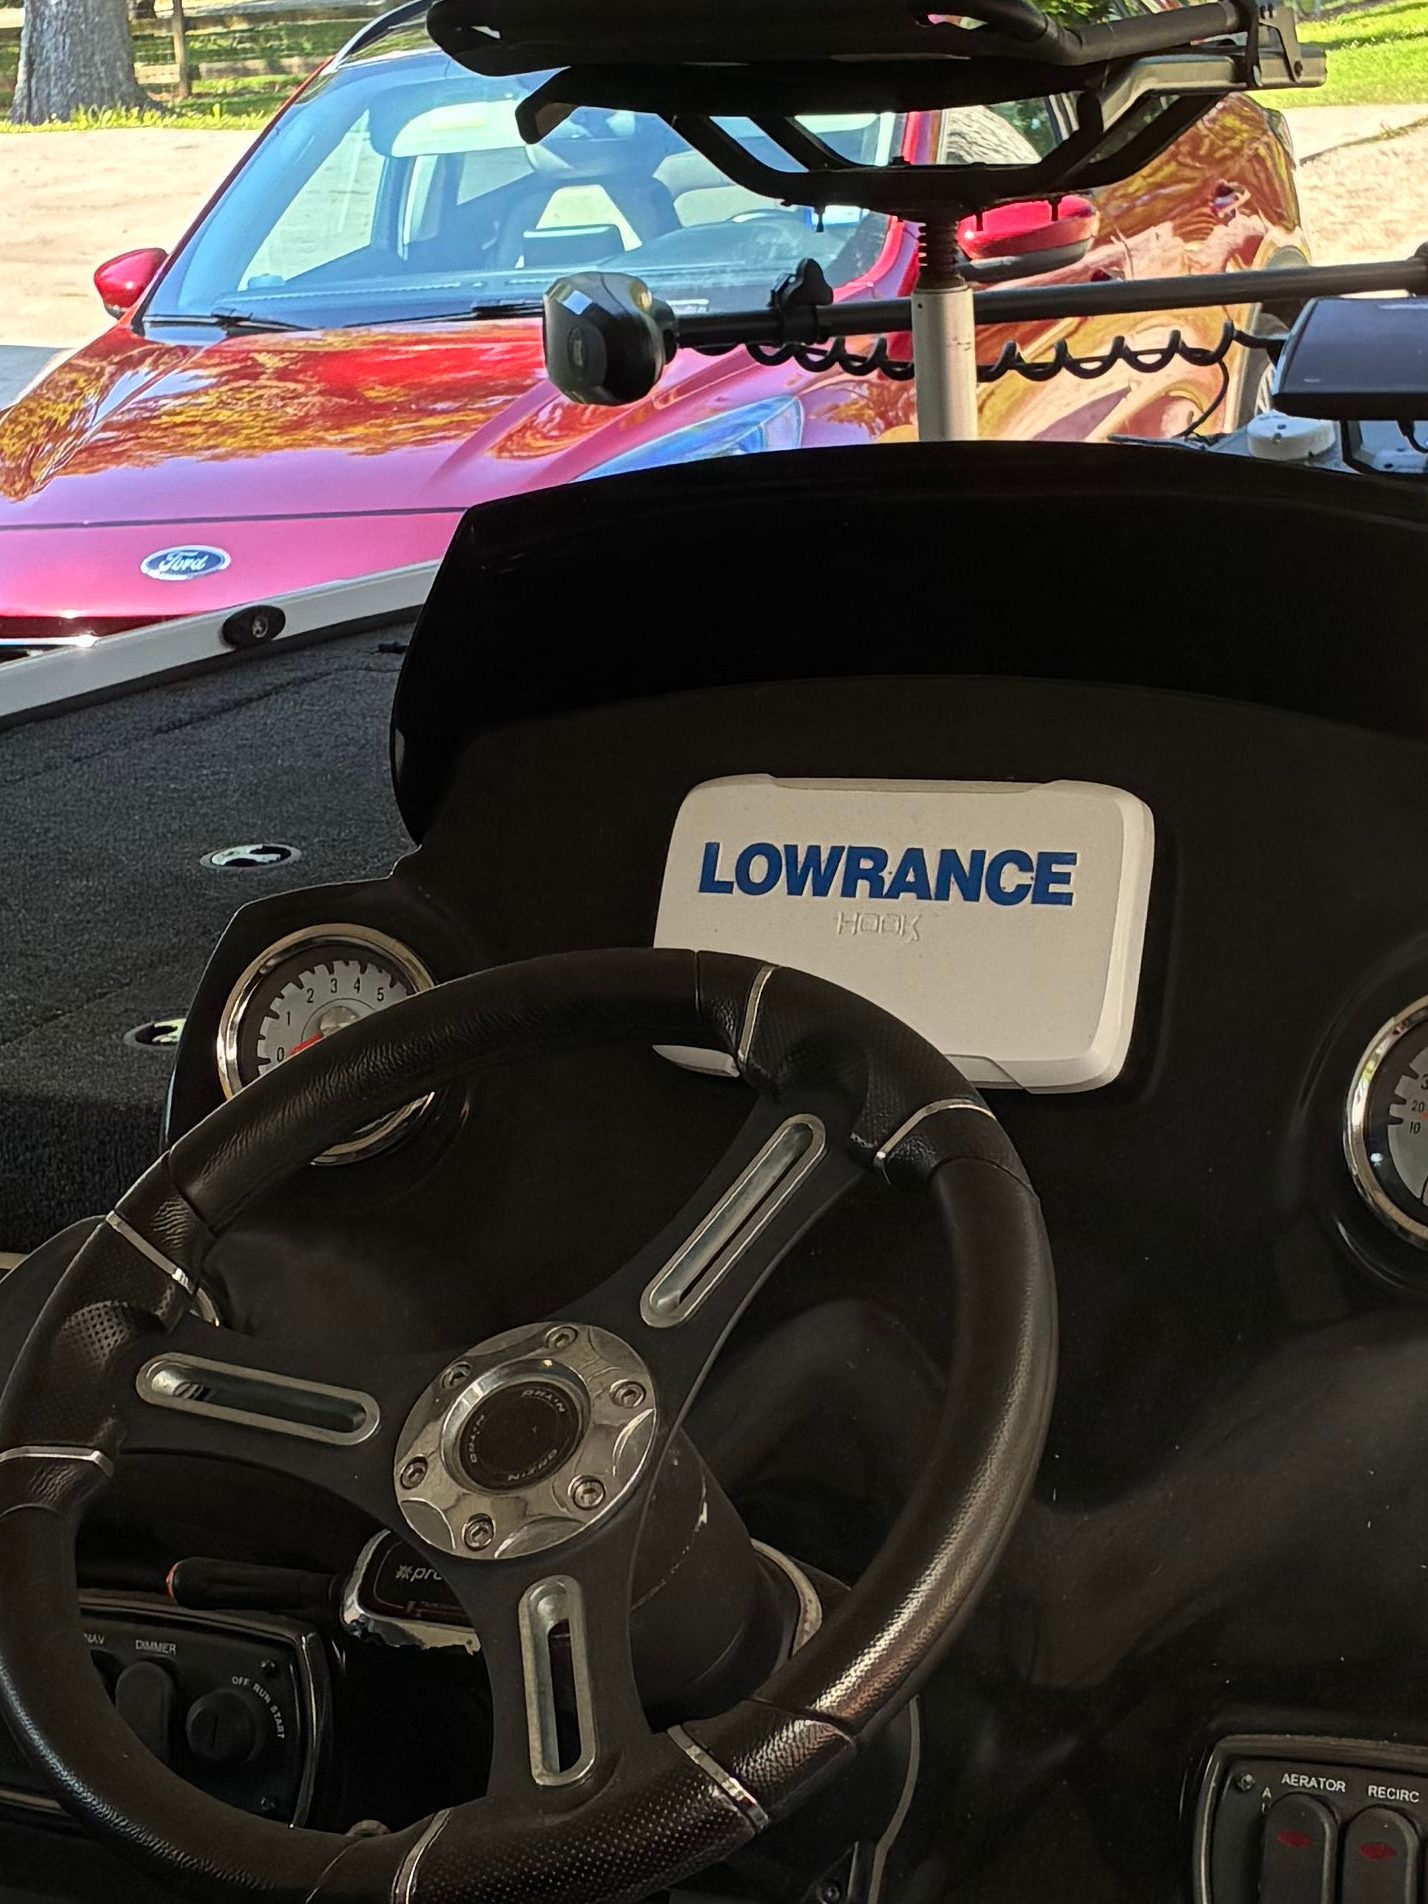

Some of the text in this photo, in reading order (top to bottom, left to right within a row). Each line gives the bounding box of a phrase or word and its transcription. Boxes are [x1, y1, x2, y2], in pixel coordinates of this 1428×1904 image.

[158, 550, 209, 572] Ford
[698, 841, 1078, 907] LOWRANCE
[836, 911, 922, 942] HOOK
[330, 978, 338, 994] 3
[353, 976, 361, 994] 4
[306, 987, 315, 1004] 2
[376, 986, 385, 1002] 5
[285, 1011, 291, 1027] 1
[276, 1046, 285, 1062] 0
[1411, 1100, 1425, 1113] 20
[1409, 1121, 1421, 1135] 10
[134, 1639, 177, 1654] DIMMER
[231, 1675, 286, 1740] OFF RUN START
[1281, 1773, 1346, 1793] AERATOR
[1368, 1785, 1420, 1803] RECIRC
